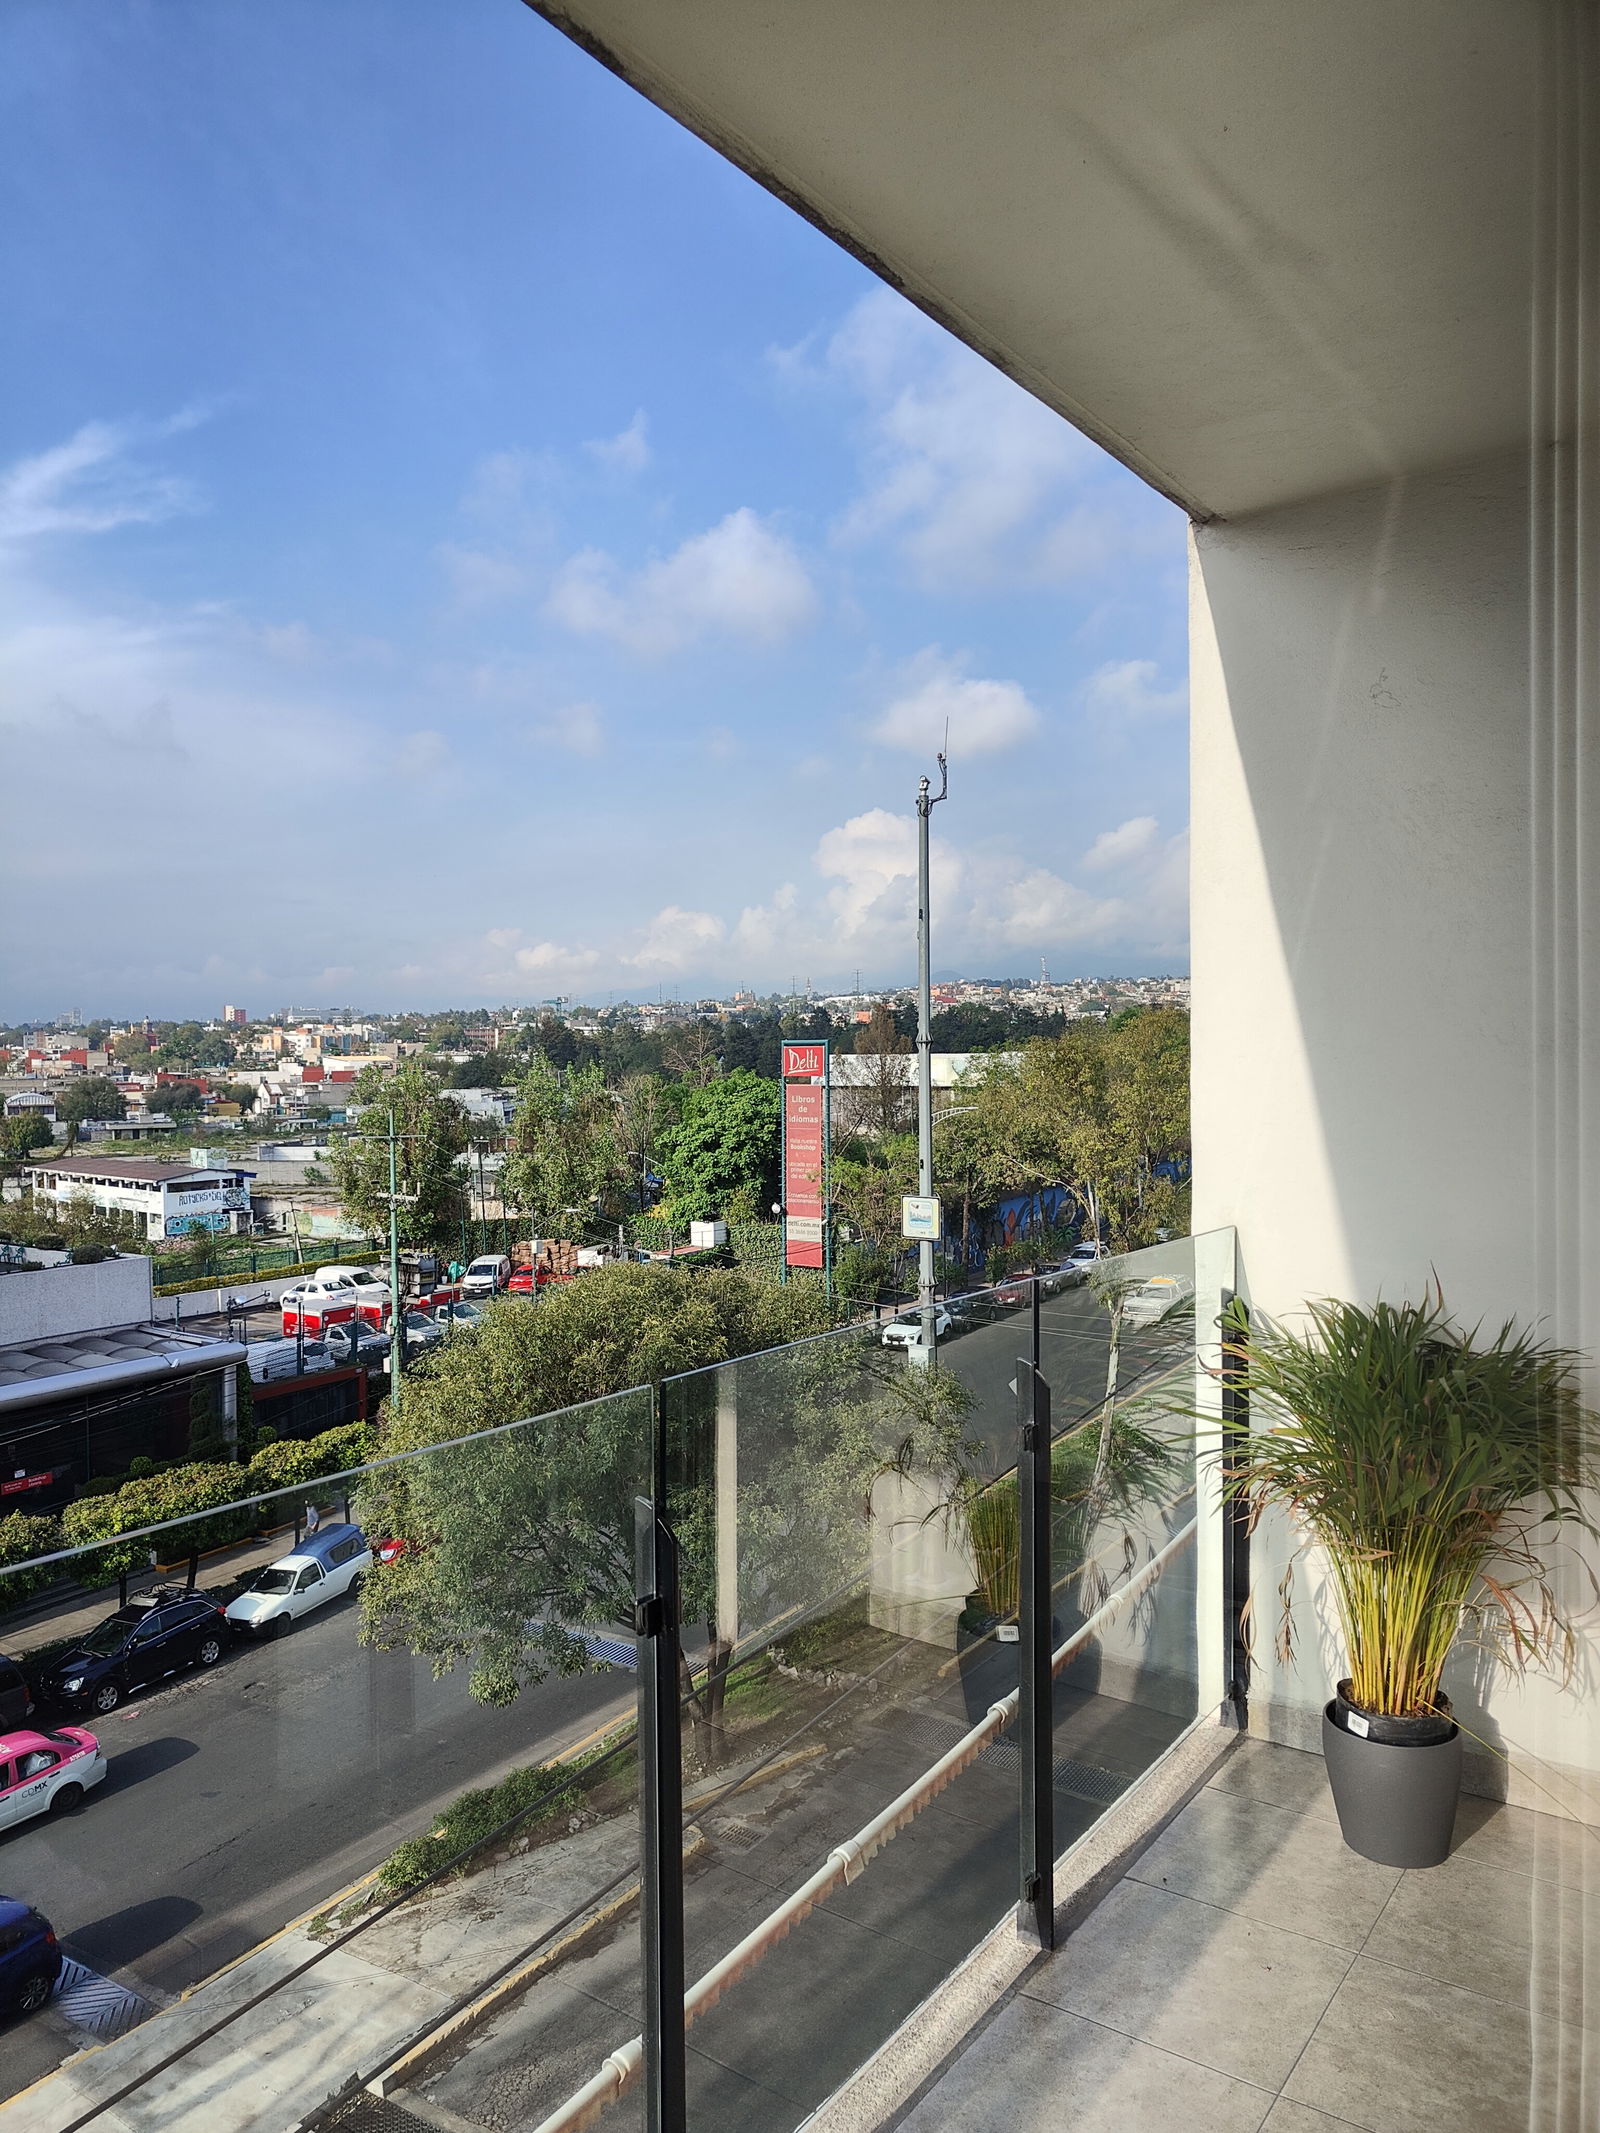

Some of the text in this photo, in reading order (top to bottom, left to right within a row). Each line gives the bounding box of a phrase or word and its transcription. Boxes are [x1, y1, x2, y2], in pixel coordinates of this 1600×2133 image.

[788, 1049, 819, 1071] Delti
[791, 1095, 815, 1104] Libros
[798, 1105, 808, 1113] de
[21, 1780, 48, 1799] CDMX
